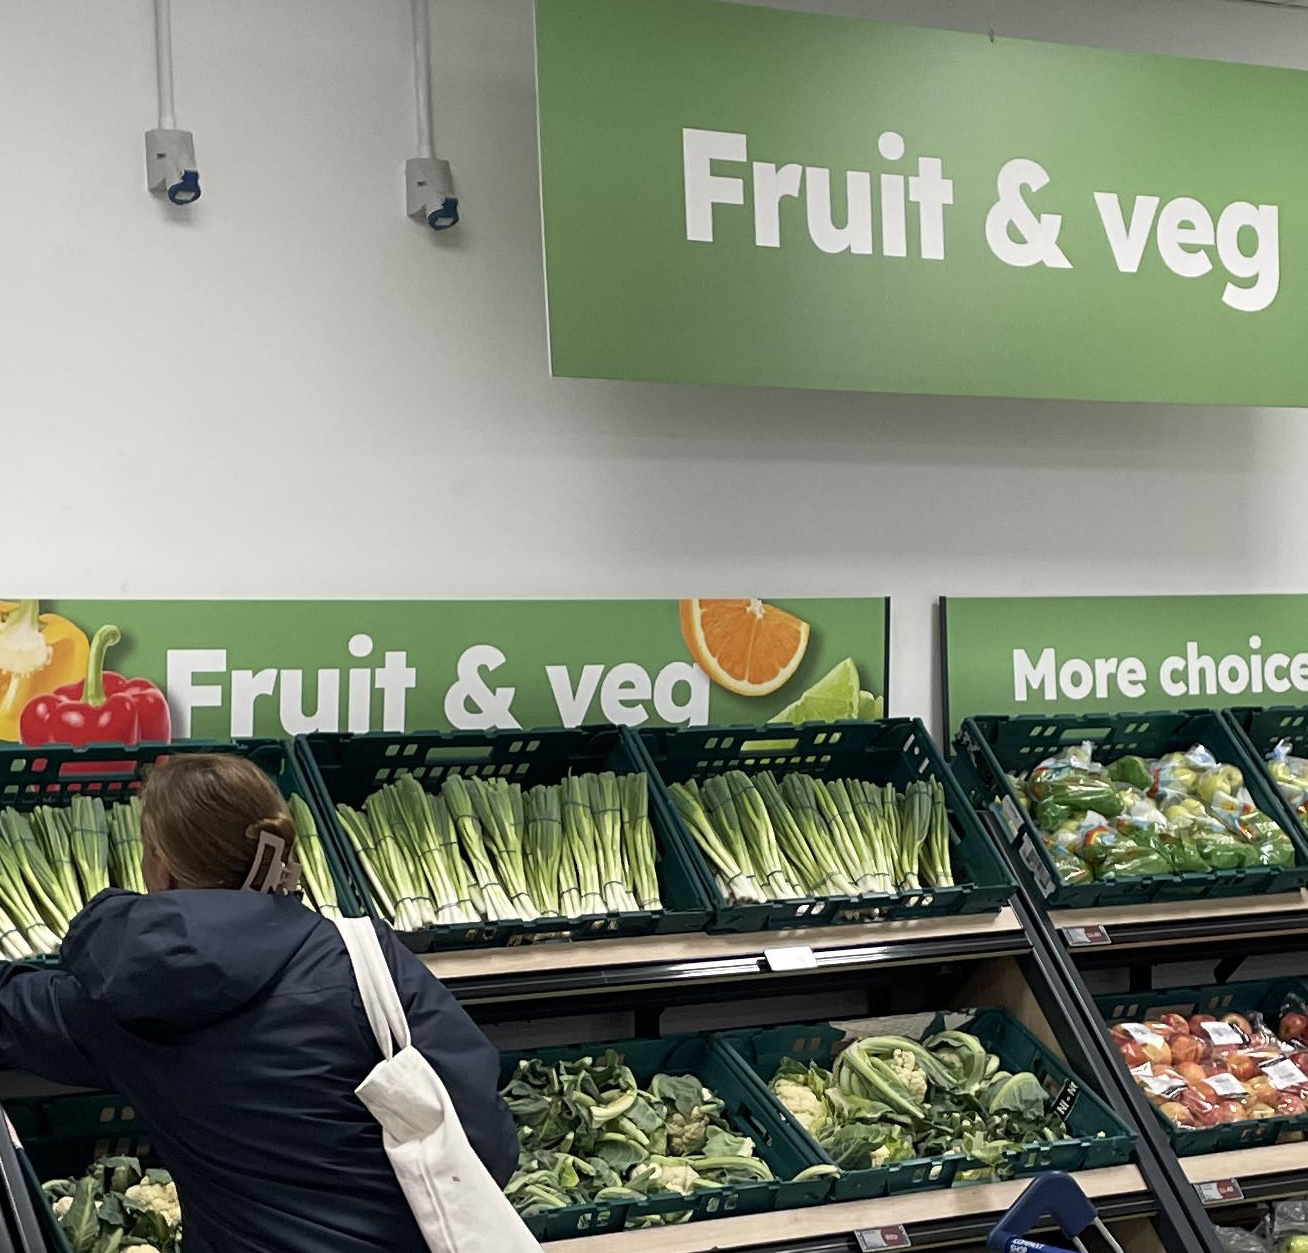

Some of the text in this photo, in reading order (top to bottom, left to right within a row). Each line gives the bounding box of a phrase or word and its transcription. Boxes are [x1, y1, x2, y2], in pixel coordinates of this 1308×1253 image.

[682, 127, 1280, 313] Fruit & veg
[166, 633, 417, 739] Fruit
[444, 644, 522, 730] &
[1012, 647, 1147, 702] More
